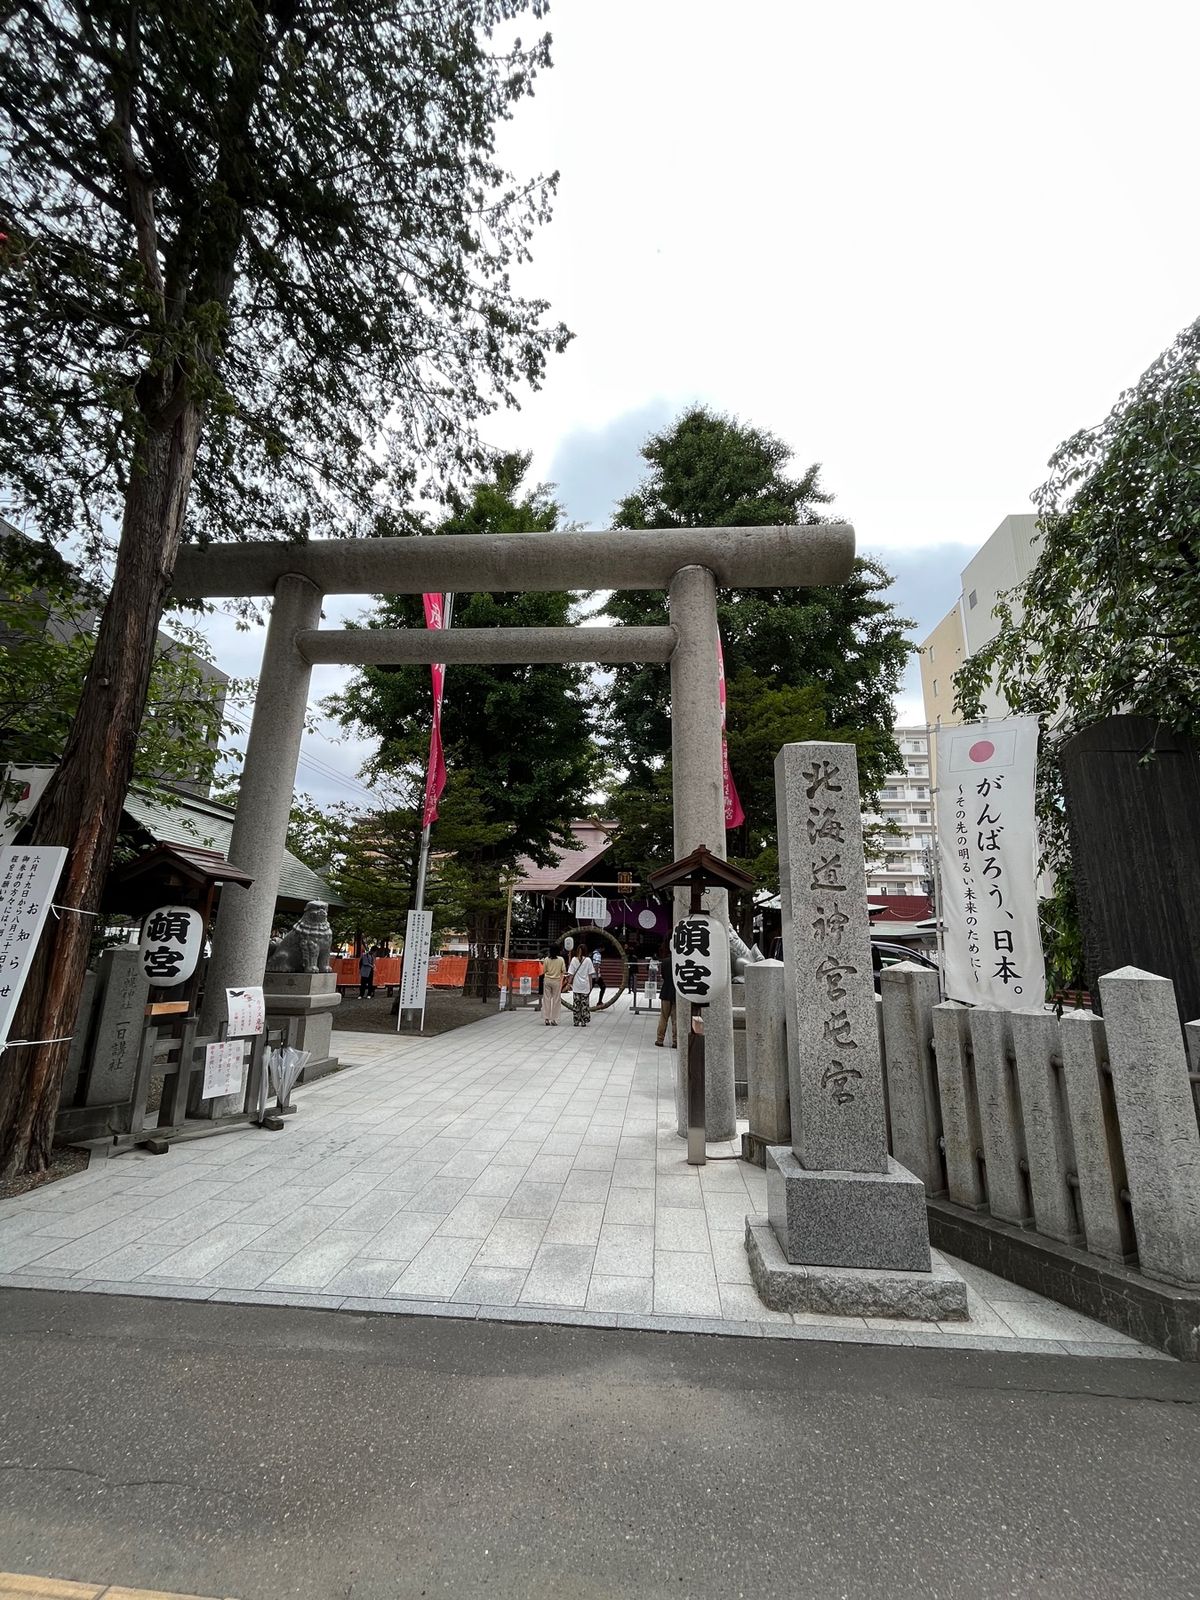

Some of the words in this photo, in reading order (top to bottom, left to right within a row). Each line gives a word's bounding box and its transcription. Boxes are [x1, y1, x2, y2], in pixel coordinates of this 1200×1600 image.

[976, 774, 1023, 995] がんばろう、日本。
[0, 902, 39, 998] お知らせ
[144, 912, 191, 977] 頓宮
[673, 920, 712, 996] 頓宮
